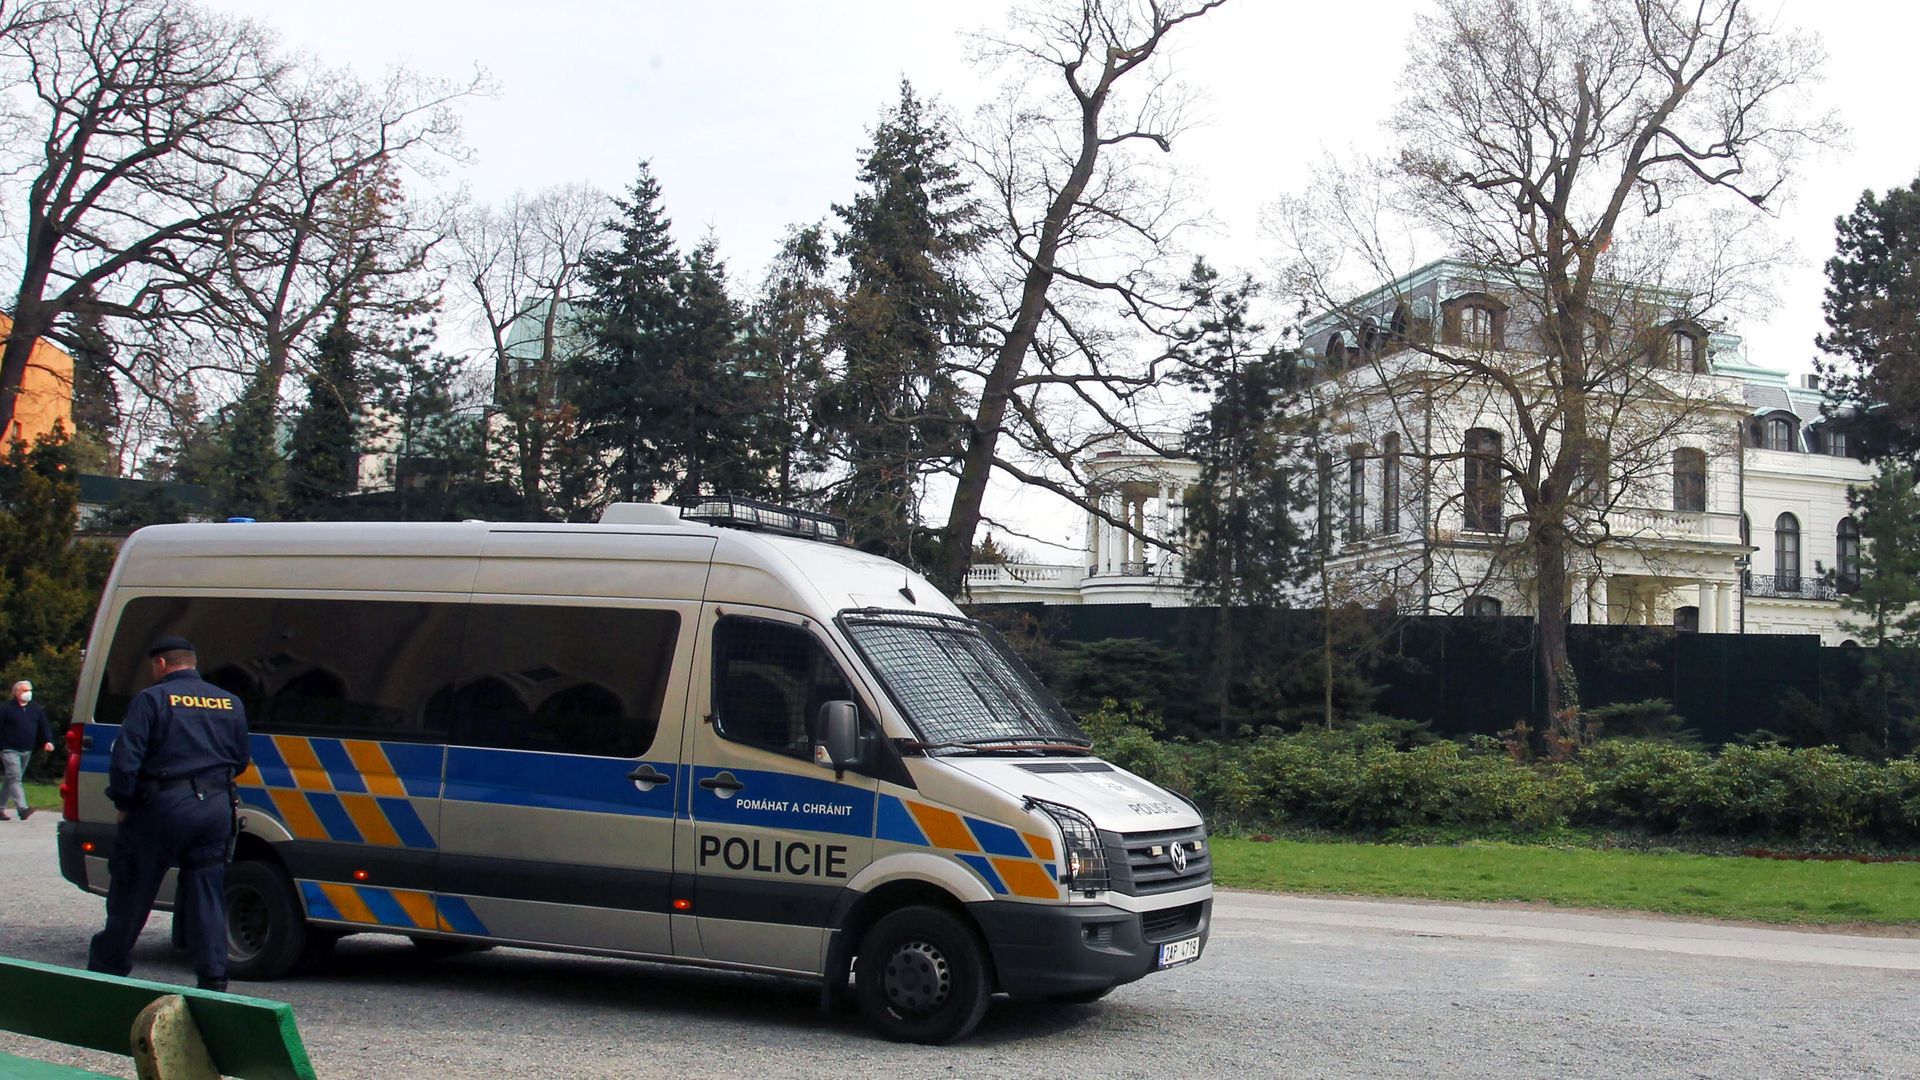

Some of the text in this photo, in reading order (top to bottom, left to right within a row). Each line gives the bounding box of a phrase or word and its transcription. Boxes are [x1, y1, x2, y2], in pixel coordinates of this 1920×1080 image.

[169, 694, 233, 710] POLICIE
[736, 798, 852, 816] POMÁHAT A CHRÁNIT
[1128, 802, 1179, 816] POLICIE
[700, 835, 847, 879] POLICIE
[1165, 940, 1197, 962] 2AP 4719
